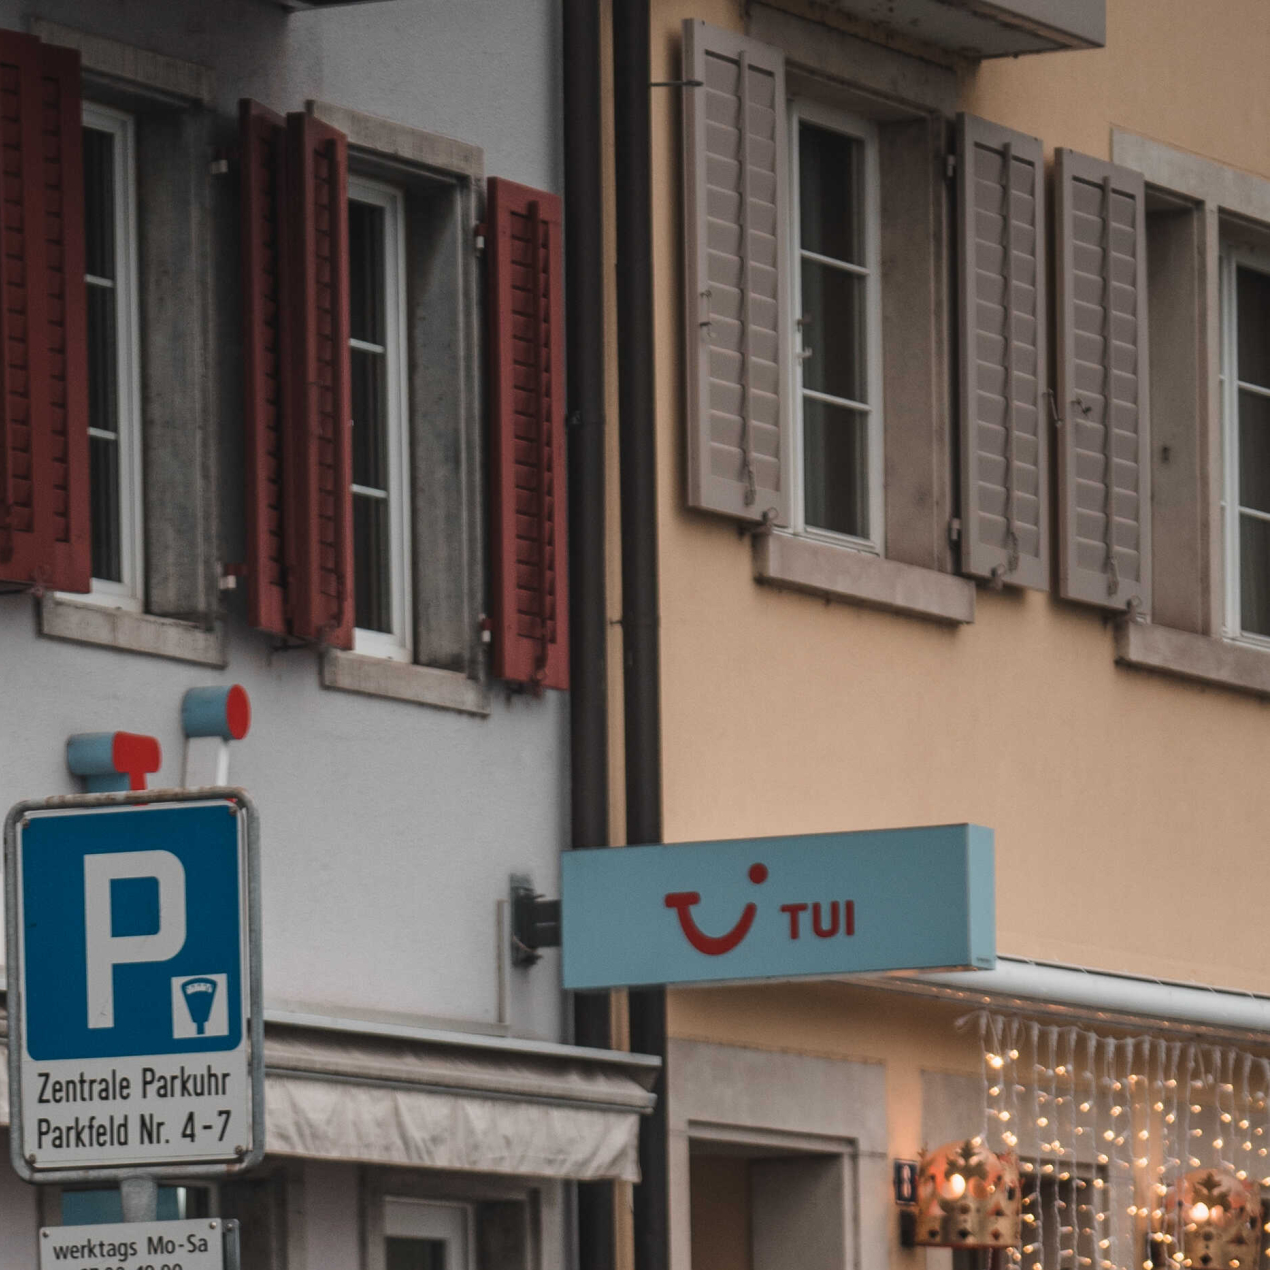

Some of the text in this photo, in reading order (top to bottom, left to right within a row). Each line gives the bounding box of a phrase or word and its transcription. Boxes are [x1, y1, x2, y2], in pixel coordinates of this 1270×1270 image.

[83, 849, 187, 1029] P
[780, 900, 855, 940] TUI
[37, 1064, 231, 1104] Zentrale Parkuhr
[37, 1114, 129, 1149] Parkfeld
[139, 1112, 170, 1145] Nr.
[902, 1164, 912, 1198] 8
[53, 1233, 209, 1262] werktags Mo-Sa
